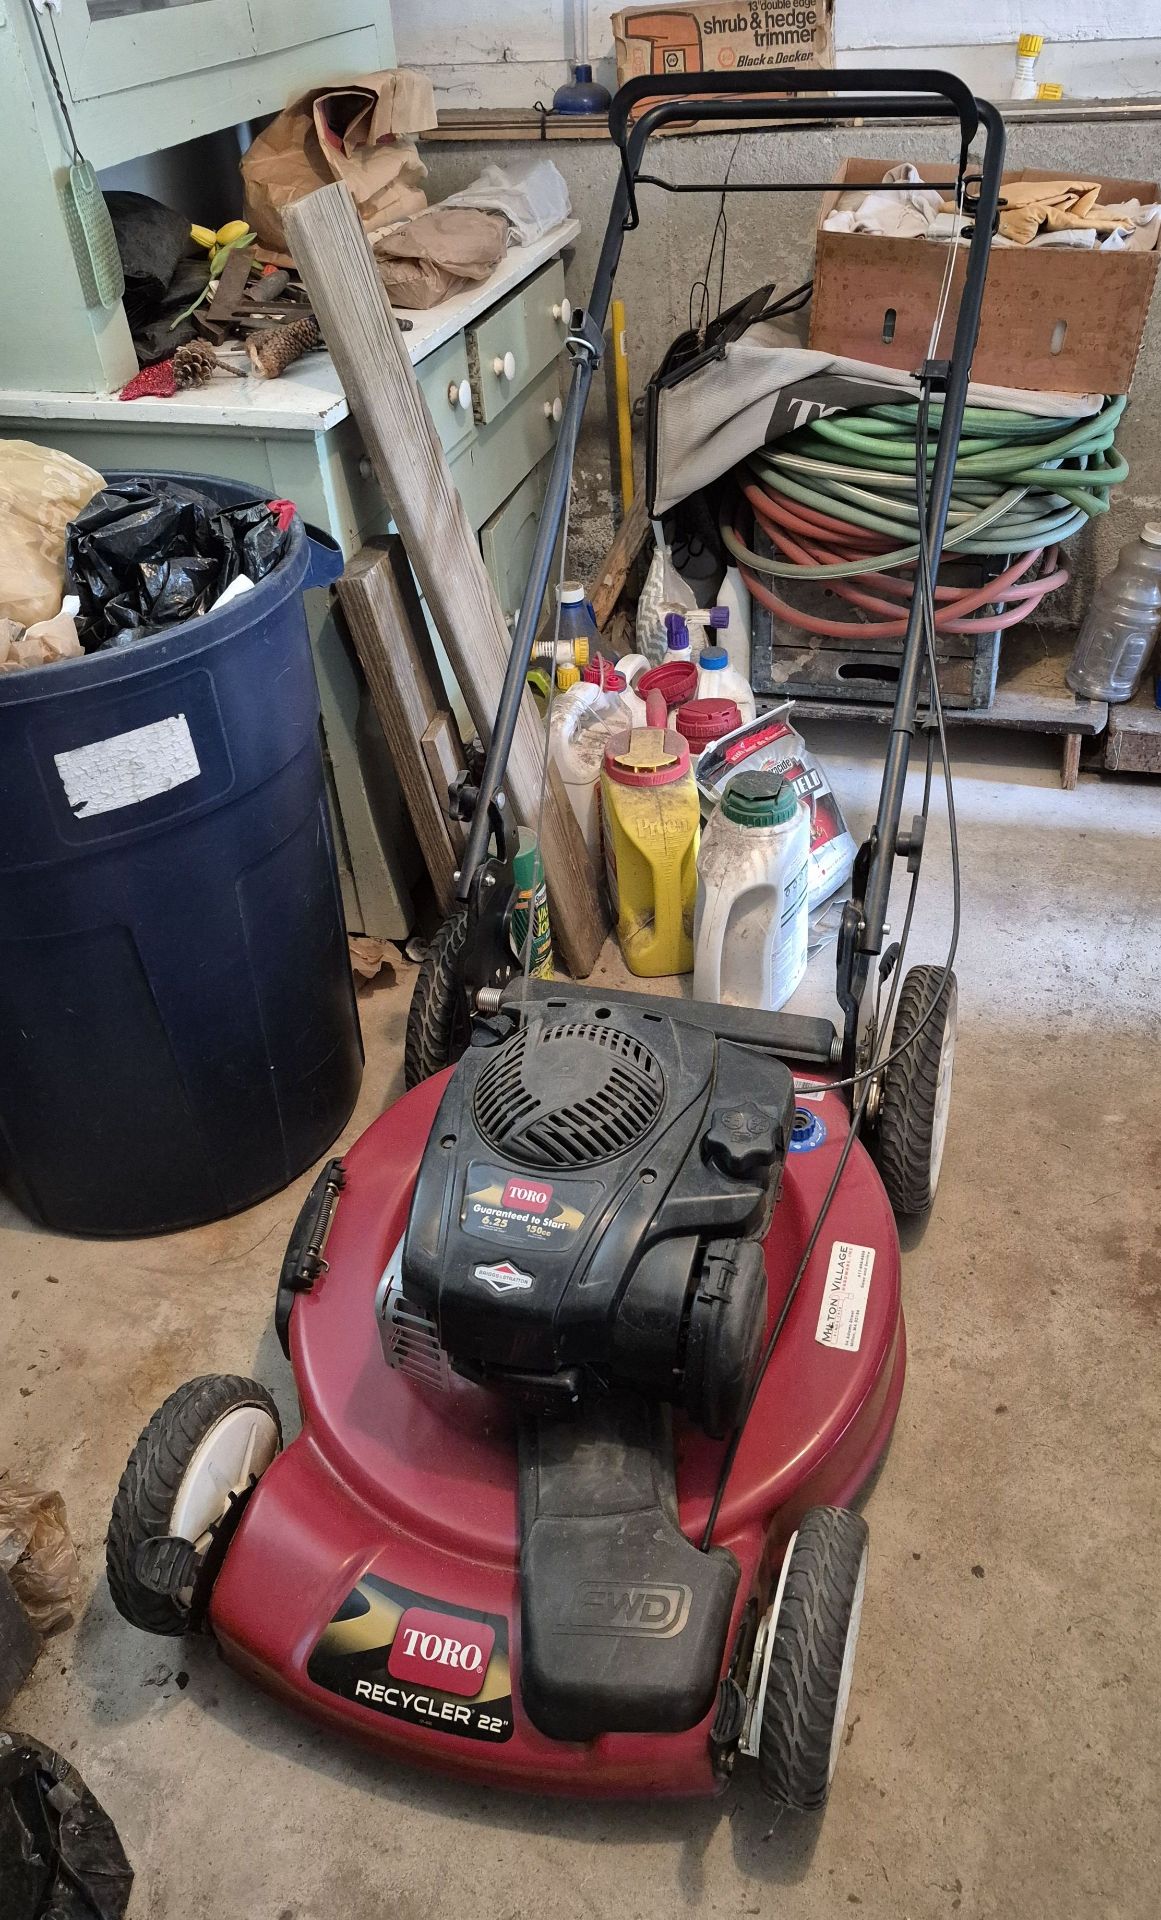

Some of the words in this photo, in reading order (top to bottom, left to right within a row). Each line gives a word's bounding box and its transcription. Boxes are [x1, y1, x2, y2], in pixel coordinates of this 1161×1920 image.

[703, 14, 747, 35] shrub
[750, 12, 762, 30] &
[765, 9, 817, 29] hedge
[754, 28, 817, 47] trimmer
[737, 53, 766, 67] Black
[767, 56, 774, 64] &
[637, 818, 689, 838] Preen
[509, 1186, 547, 1204] TORO
[473, 1203, 530, 1222] Guaranteed
[531, 1215, 541, 1225] to
[481, 1216, 508, 1228] 6.25
[526, 1224, 551, 1237] 150cc
[822, 1298, 838, 1342] MILTON
[831, 1246, 848, 1291] VILLAGE
[581, 1591, 671, 1622] FWD
[403, 1628, 482, 1672] TORO
[355, 1679, 472, 1725] RECYCLER
[477, 1714, 509, 1733] 22"
